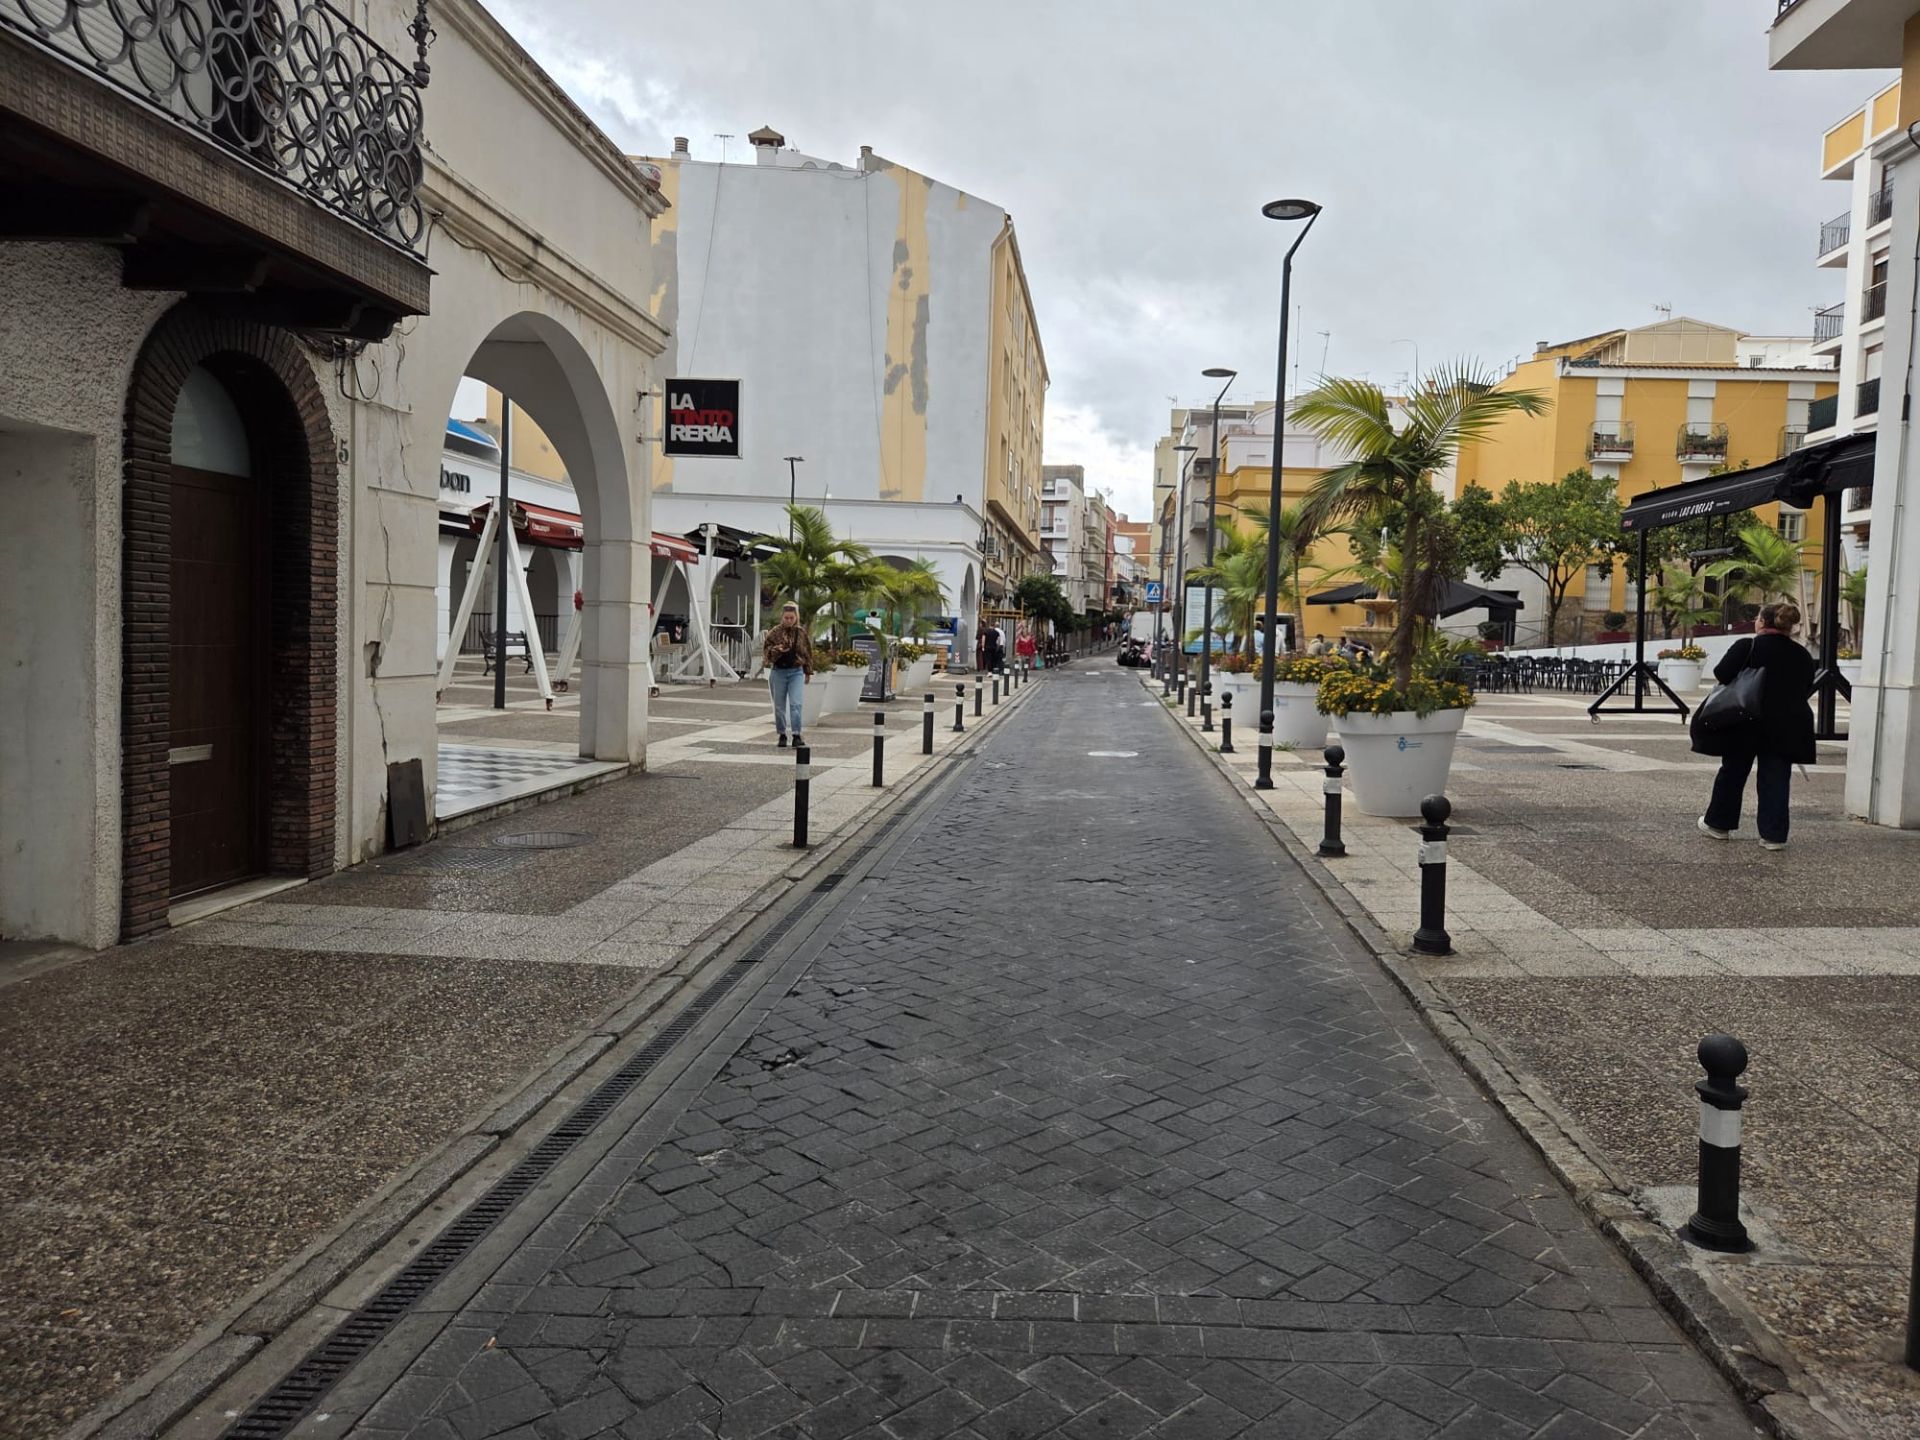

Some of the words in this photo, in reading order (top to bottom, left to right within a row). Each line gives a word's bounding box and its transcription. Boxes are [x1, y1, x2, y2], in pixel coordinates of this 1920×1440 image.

[671, 393, 695, 410] LA
[671, 409, 734, 426] TINTO
[671, 422, 734, 443] RERÍA
[338, 438, 349, 464] 5
